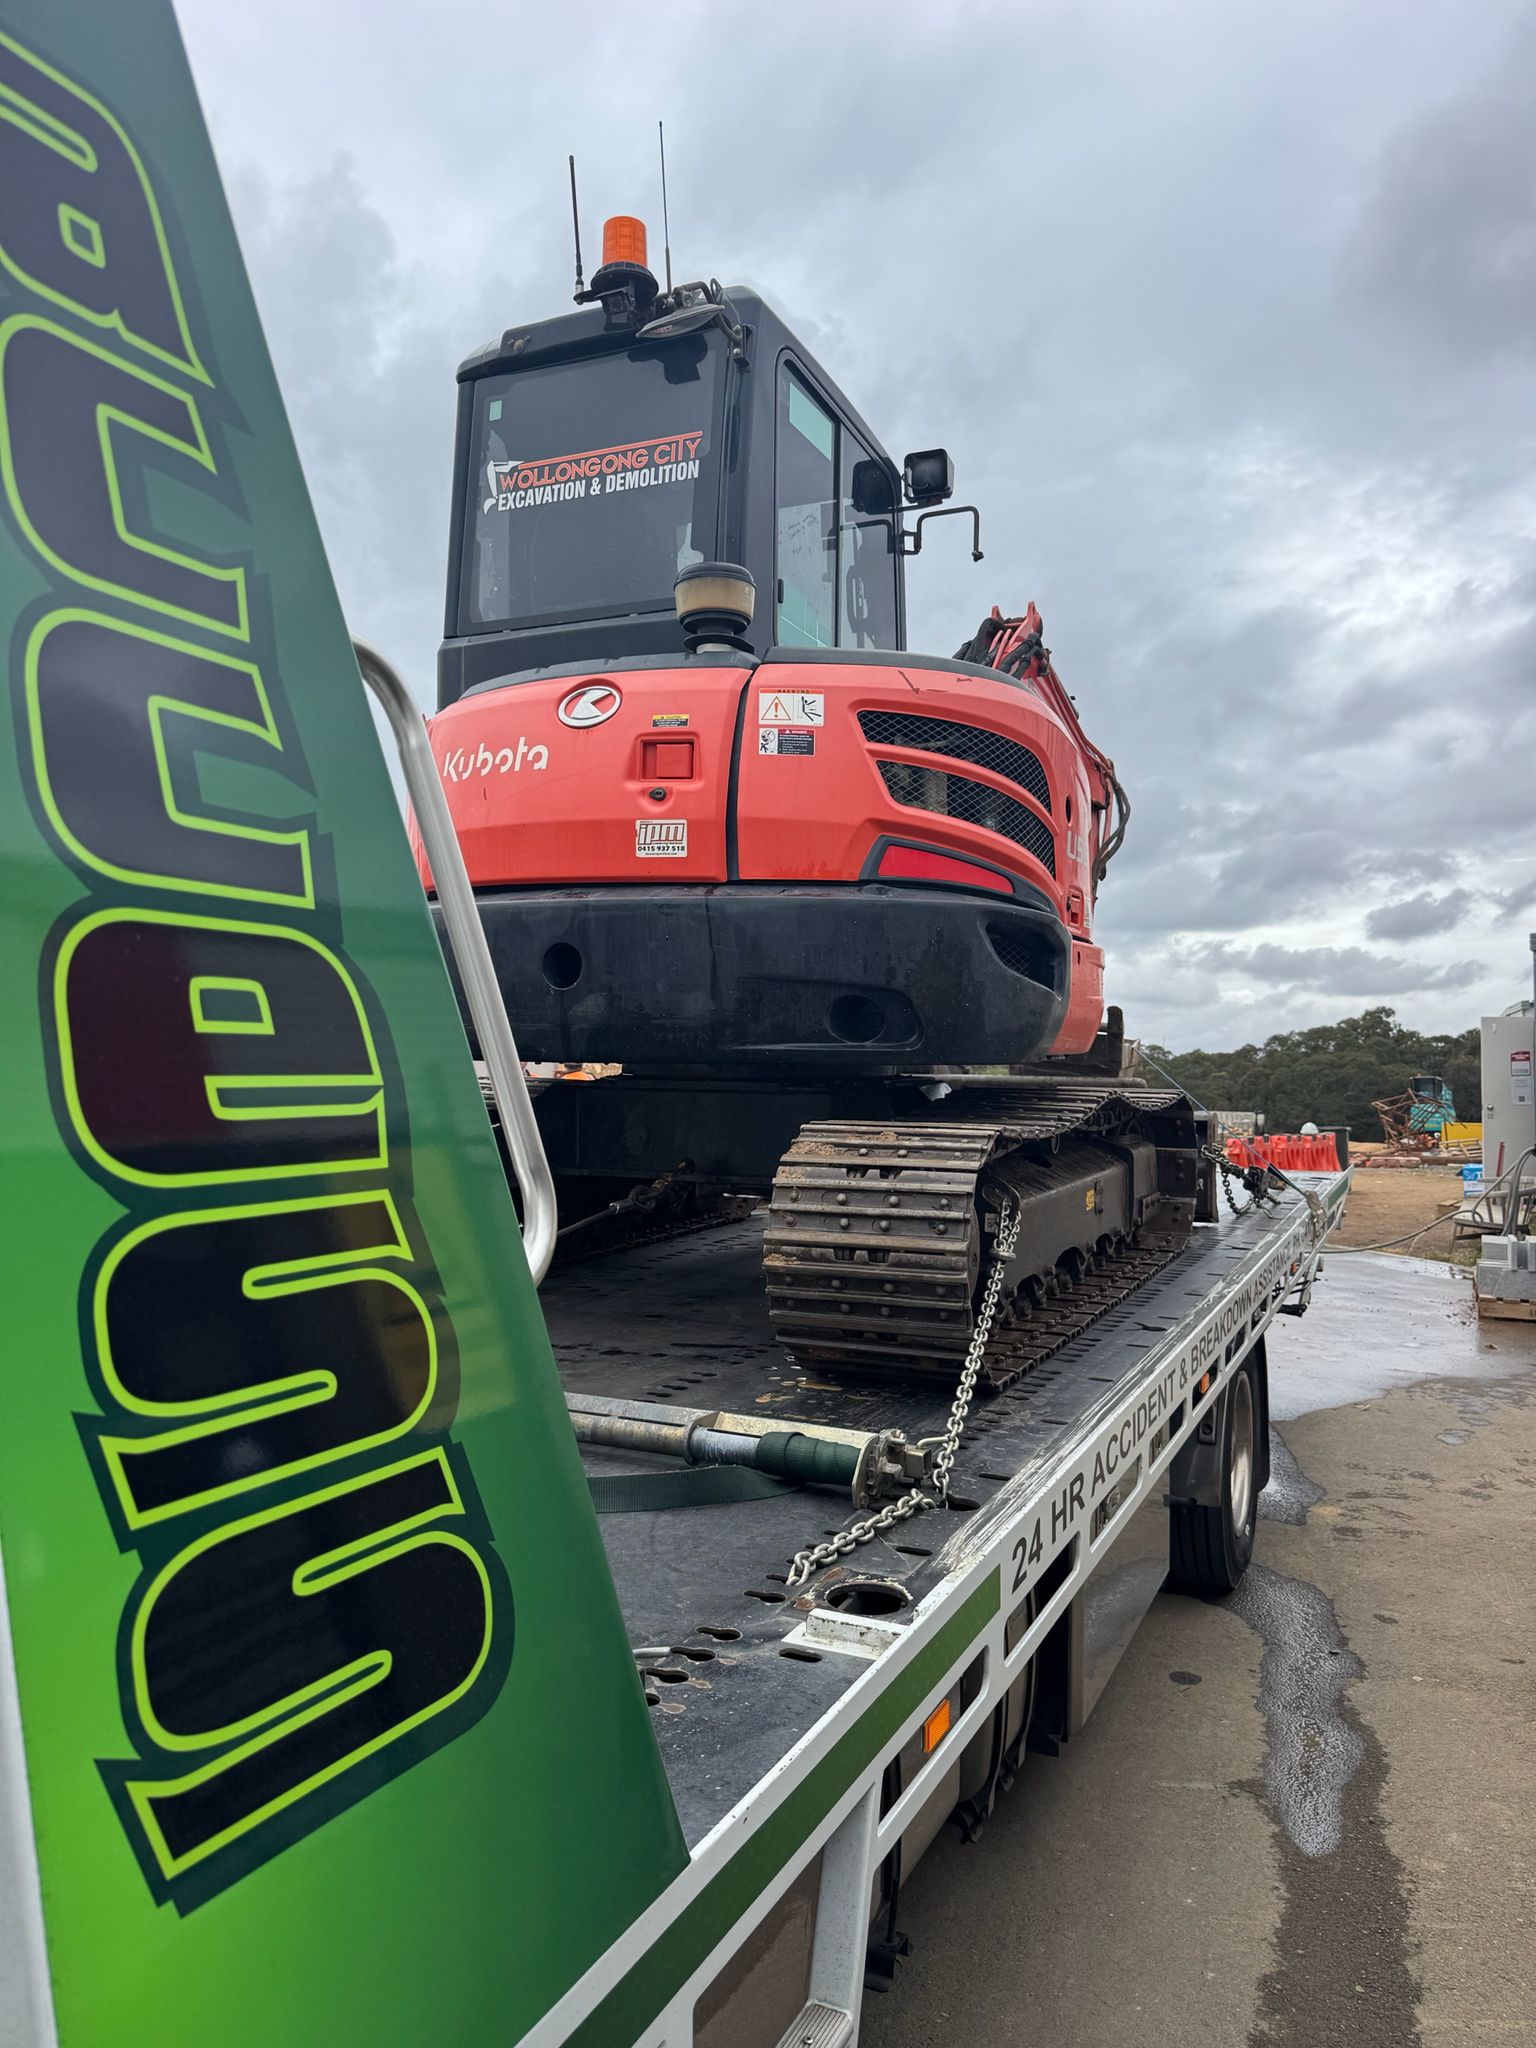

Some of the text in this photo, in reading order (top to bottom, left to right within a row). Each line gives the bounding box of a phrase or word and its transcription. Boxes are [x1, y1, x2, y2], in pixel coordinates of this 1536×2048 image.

[498, 459, 700, 511] EXCAVATION & DEMOLITION
[500, 437, 702, 492] WOLLONGONG CITY
[443, 736, 549, 782] Kubota
[1012, 1517, 1044, 1595] 24
[1051, 1471, 1086, 1545] HR
[1090, 1368, 1177, 1498] ACCIDENT
[1179, 1357, 1188, 1390] &
[1191, 1284, 1253, 1377] BREAKDOWN
